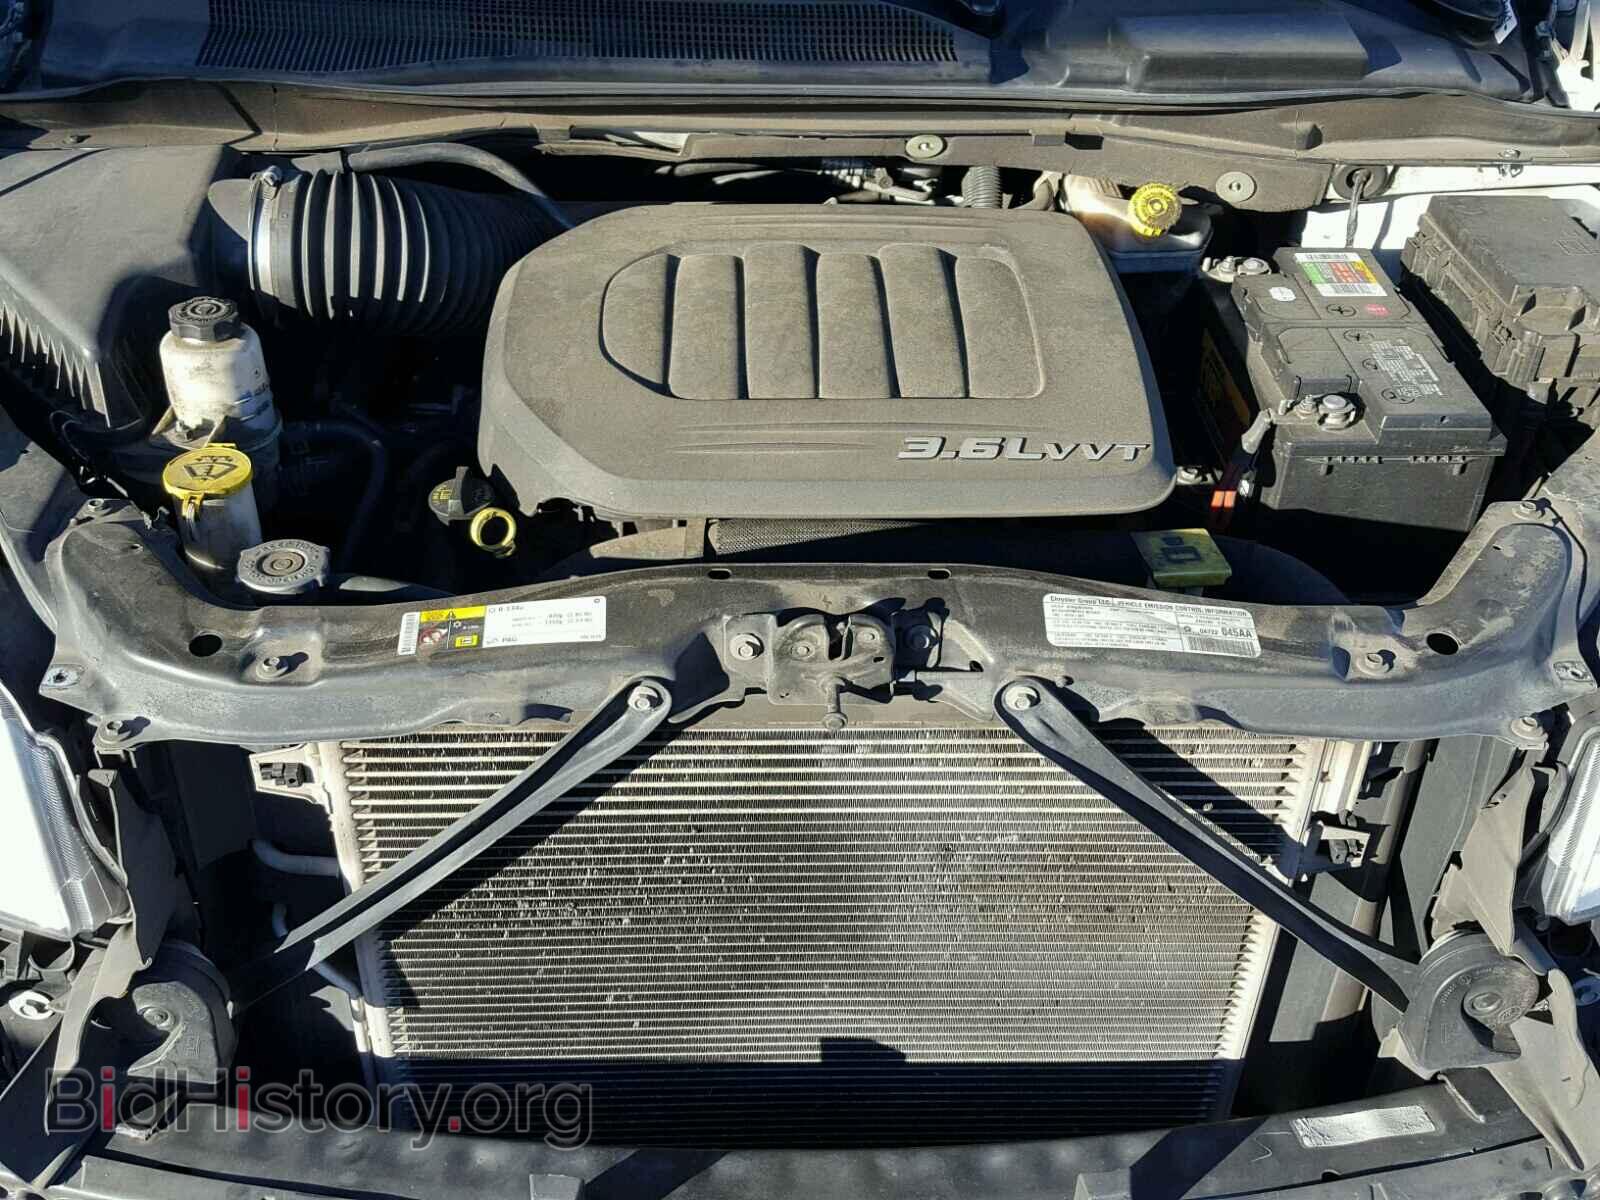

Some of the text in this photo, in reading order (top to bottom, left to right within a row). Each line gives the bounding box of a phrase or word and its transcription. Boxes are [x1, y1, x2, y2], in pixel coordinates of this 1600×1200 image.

[1144, 602, 1174, 611] EMISSION
[1175, 605, 1203, 614] CONTROL
[1204, 607, 1248, 617] INFORMATION
